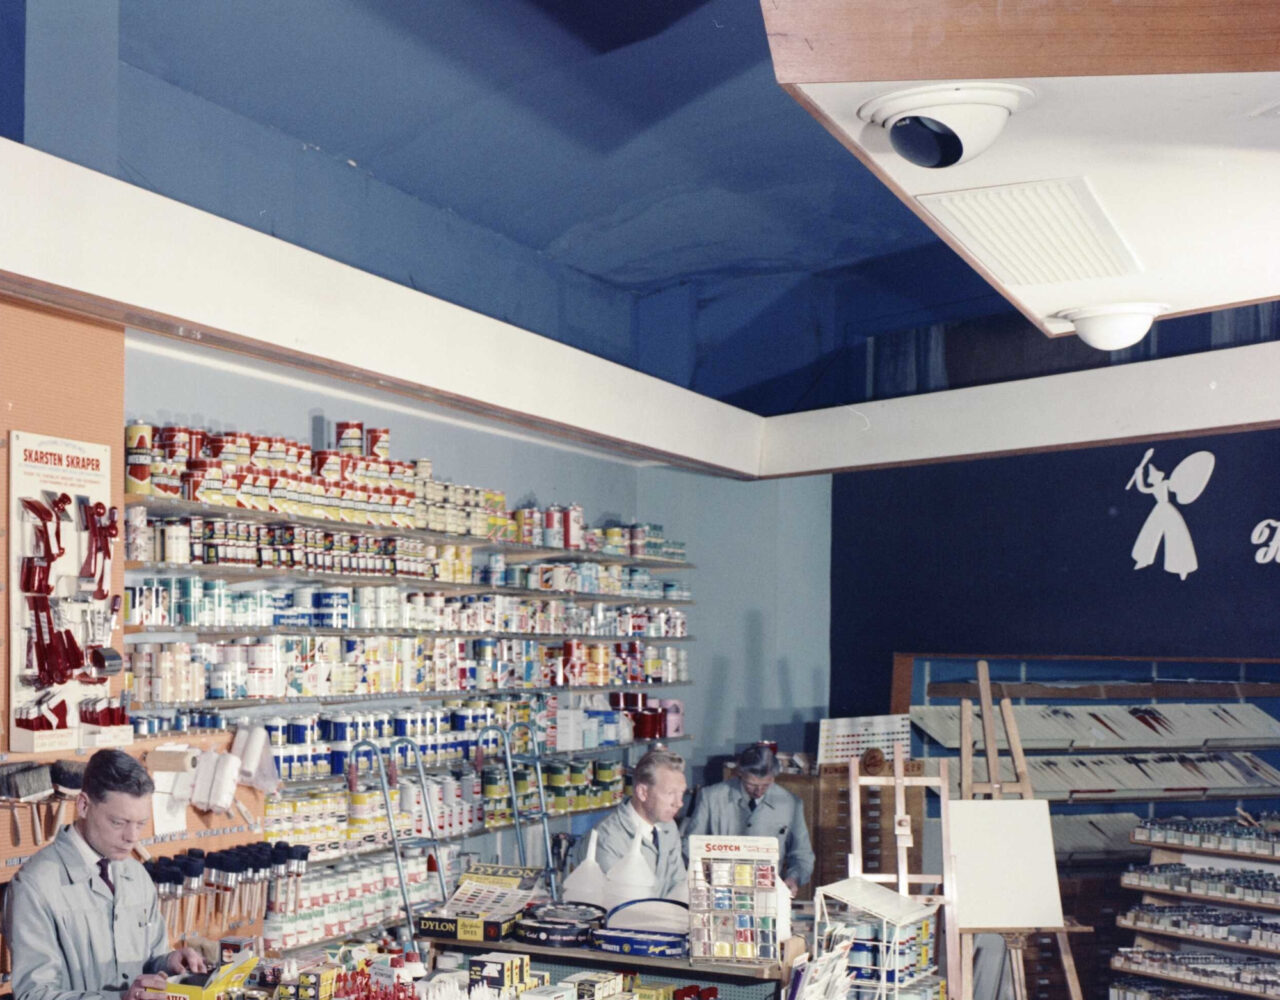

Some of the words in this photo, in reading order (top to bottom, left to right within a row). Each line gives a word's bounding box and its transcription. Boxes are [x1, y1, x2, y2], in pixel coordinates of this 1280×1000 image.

[23, 449, 63, 466] SKARSTEN
[66, 455, 100, 472] SKRAPER
[705, 842, 740, 852] SCOTCH
[470, 866, 540, 879] DYLON
[421, 919, 456, 932] DYLON
